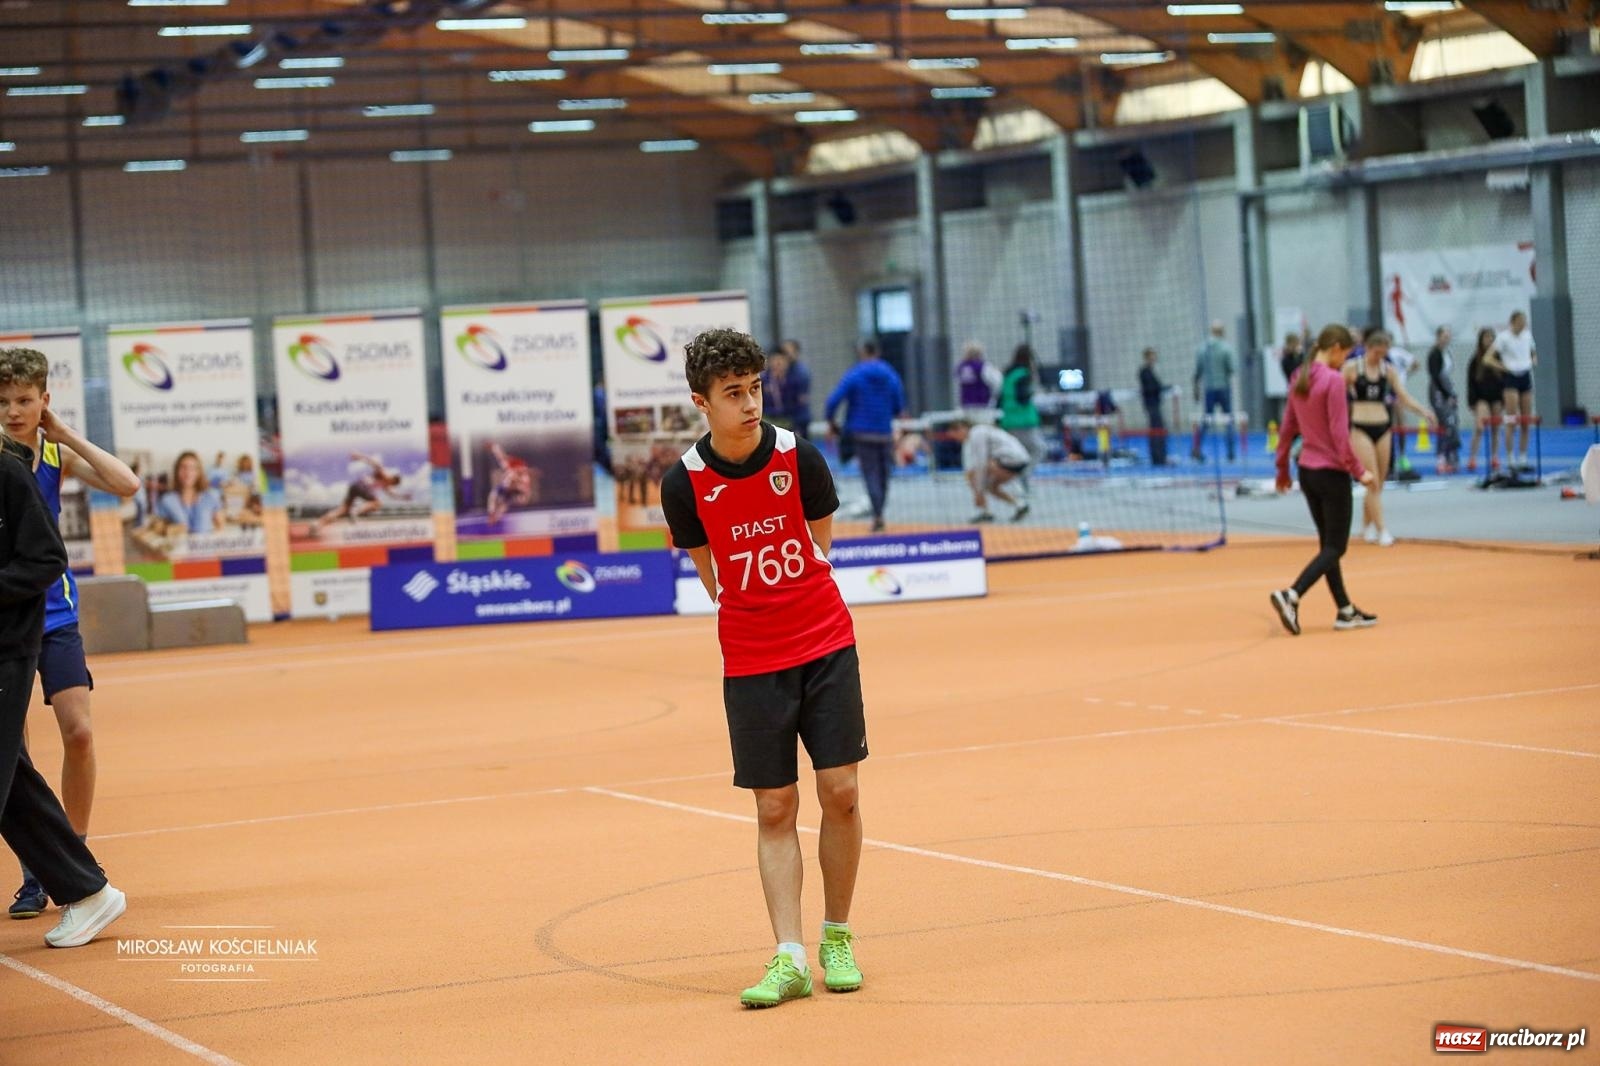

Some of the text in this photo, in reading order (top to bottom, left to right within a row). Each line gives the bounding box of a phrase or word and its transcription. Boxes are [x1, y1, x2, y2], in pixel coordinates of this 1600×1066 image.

[731, 515, 787, 541] PIAST
[729, 539, 805, 591] 768
[829, 544, 906, 562] PORTOWEGO
[447, 567, 531, 596] Śląskie.
